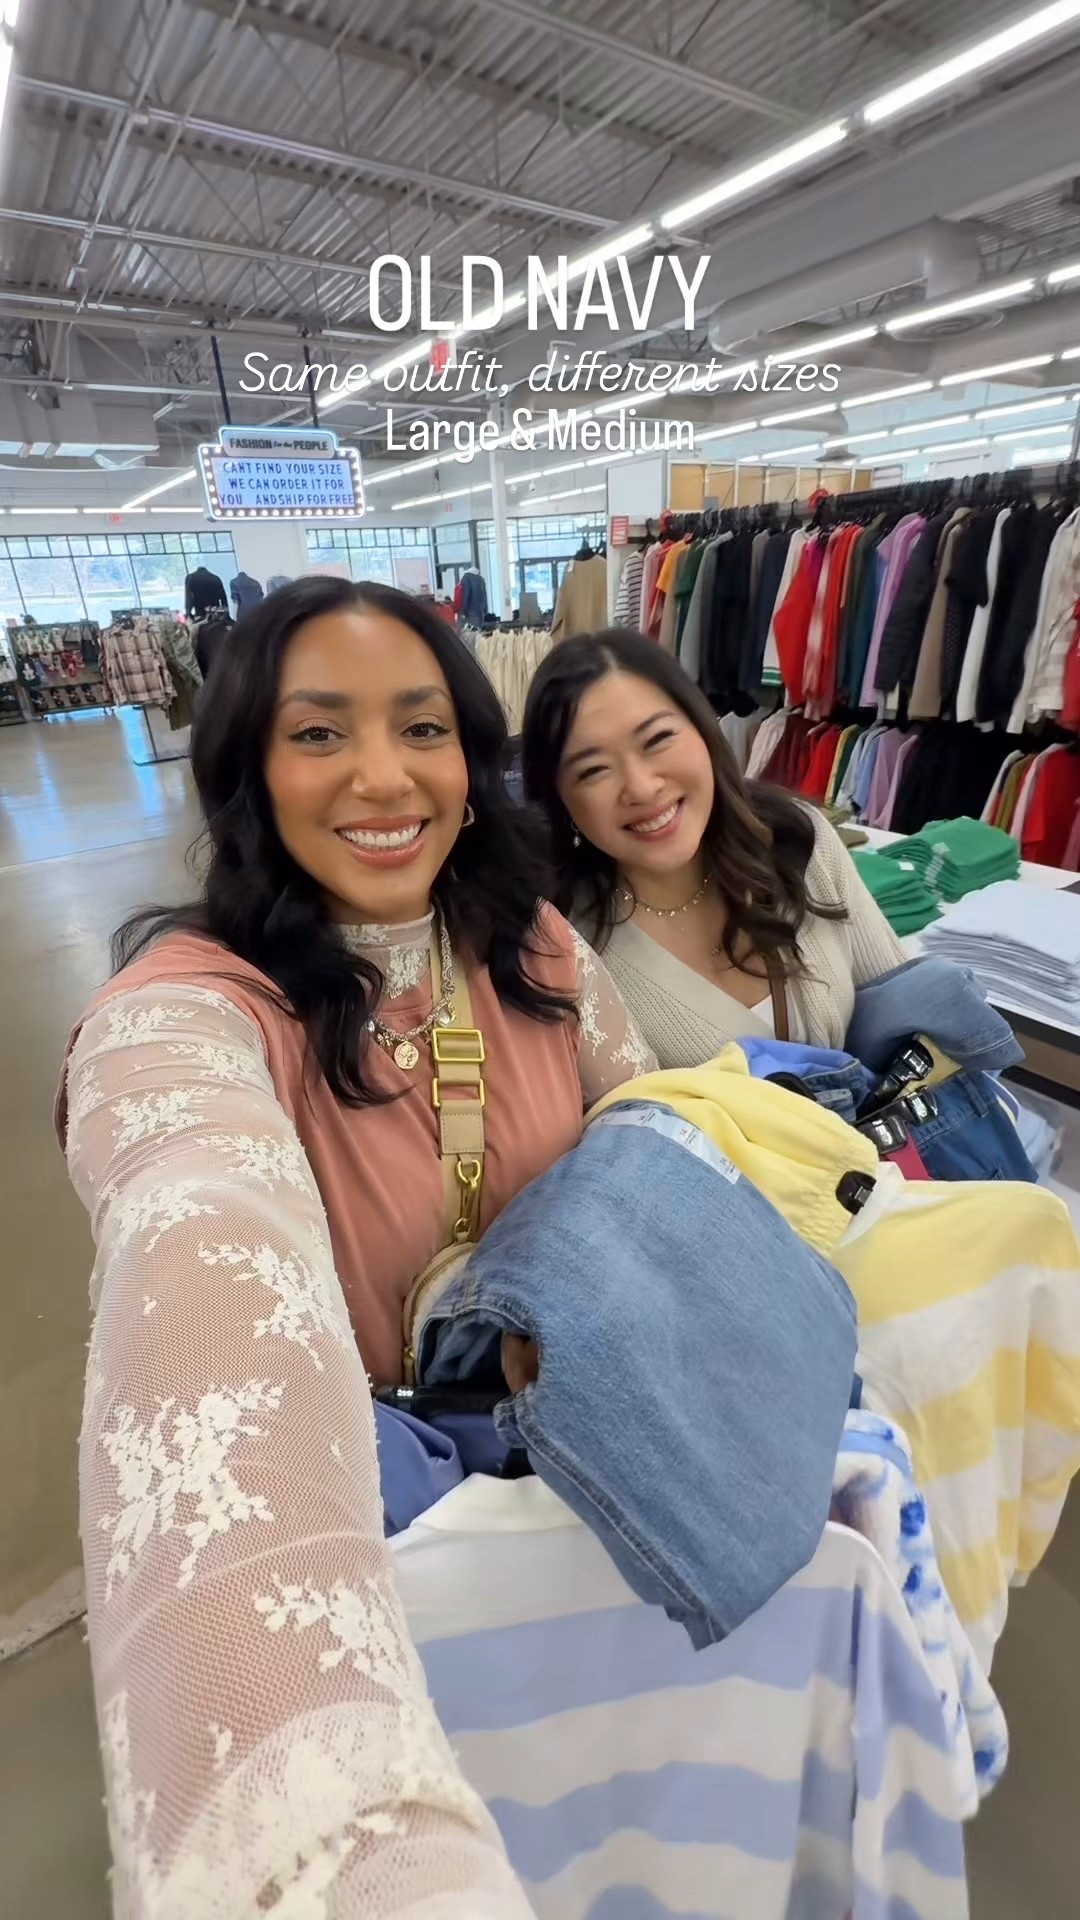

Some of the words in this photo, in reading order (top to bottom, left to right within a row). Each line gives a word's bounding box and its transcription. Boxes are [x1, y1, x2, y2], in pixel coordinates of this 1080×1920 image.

[229, 438, 272, 449] FASHION
[293, 440, 329, 451] PEOPLE
[223, 462, 252, 474] CANT
[256, 463, 282, 474] FIND
[284, 463, 316, 475] YOUR
[319, 464, 343, 475] SIZE
[228, 478, 245, 489] WE
[248, 478, 270, 490] CAN
[272, 478, 309, 490] ORDER
[311, 479, 322, 490] IT
[325, 479, 345, 489] FOR
[219, 494, 243, 505] YOU
[255, 494, 277, 505] AND
[280, 494, 304, 505] SHIP
[307, 494, 327, 505] FOR
[329, 493, 354, 504] FREE
